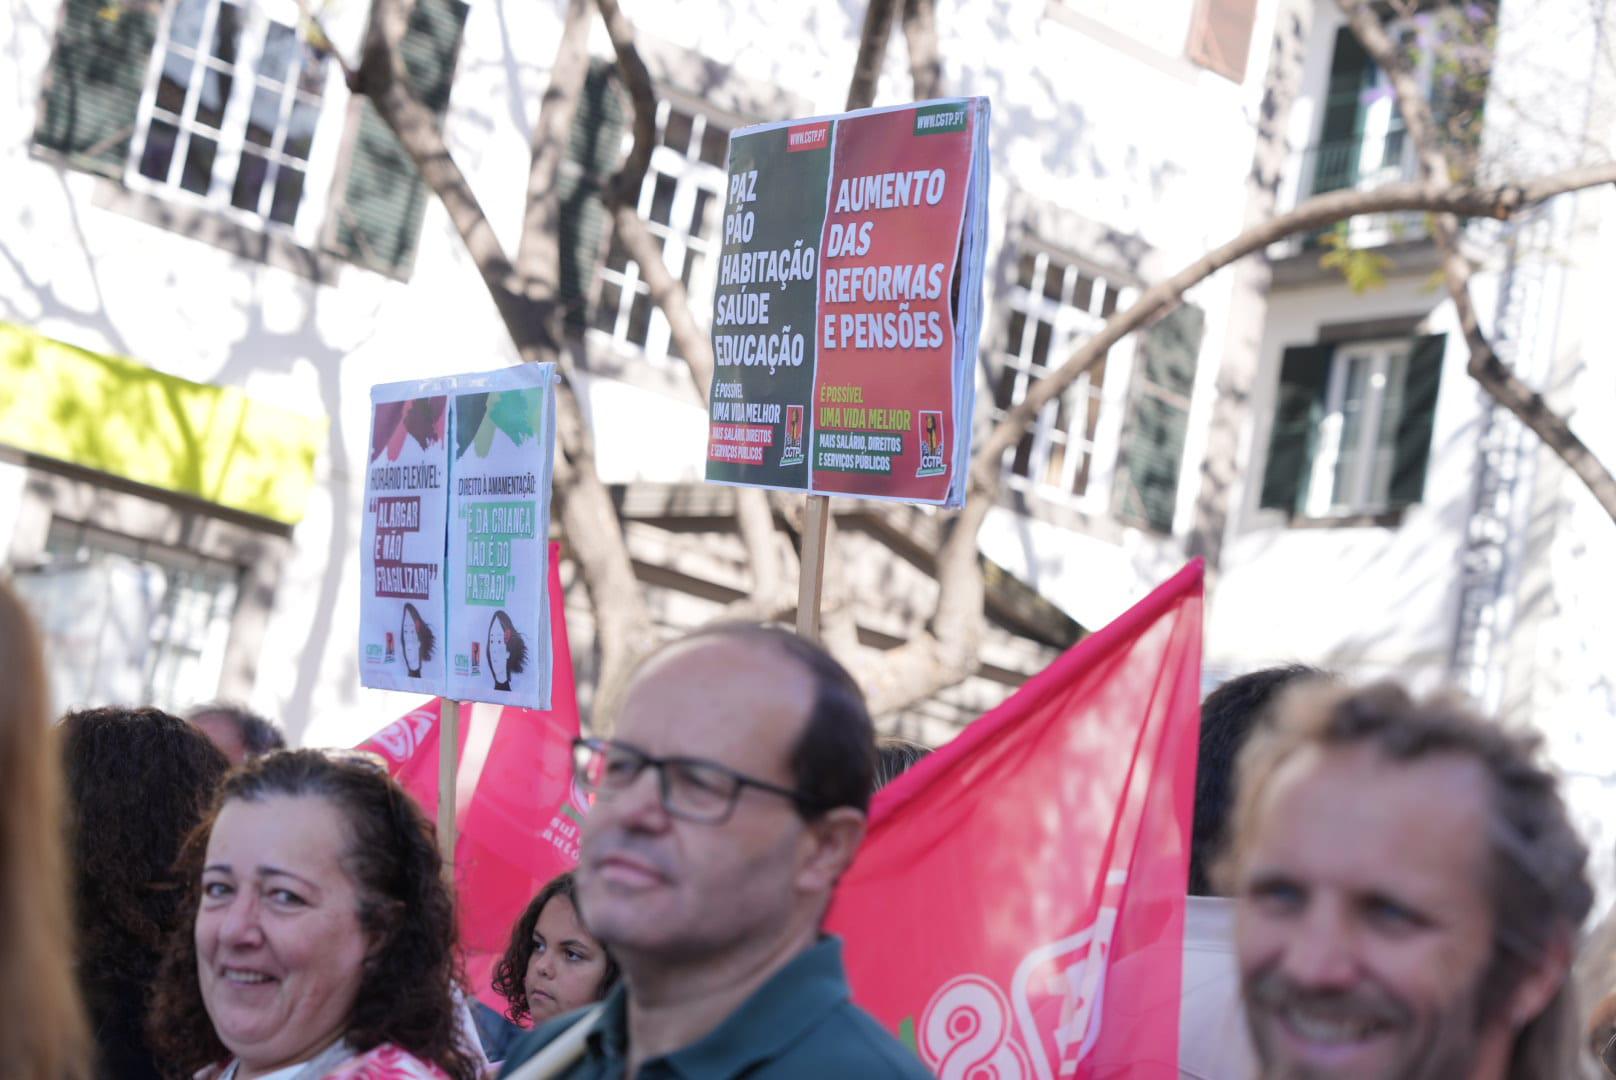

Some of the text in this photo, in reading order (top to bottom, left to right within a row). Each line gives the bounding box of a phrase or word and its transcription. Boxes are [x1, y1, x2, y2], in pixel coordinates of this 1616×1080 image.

[917, 111, 964, 129] WWW.CGTP.PT
[729, 170, 758, 205] PAZ
[835, 168, 945, 213] AUMENTO
[725, 203, 755, 245] PÃO
[827, 221, 874, 257] DAS
[720, 239, 815, 290] HABITAÇÃO
[825, 263, 944, 303] REFORMAS
[716, 285, 770, 325] SAÚDE
[824, 302, 943, 348] E PENSÕES
[715, 325, 804, 375] EDUCAÇÃO
[821, 382, 864, 403] É POSSÍVEL
[713, 402, 781, 423] UMA VIDA MELHOR
[820, 408, 911, 431] UMA VIDA MELHOR
[819, 432, 901, 452] MAIS SALÁRIO, DIREITOS
[819, 453, 823, 467] E
[824, 453, 854, 471] SERVIÇOS
[855, 451, 891, 471] PÚBLICOS
[458, 477, 481, 496] DIREITO
[482, 474, 487, 495] À
[476, 508, 489, 534] DA
[376, 530, 402, 560] E NÃO
[488, 535, 494, 566] É
[497, 541, 508, 567] DO
